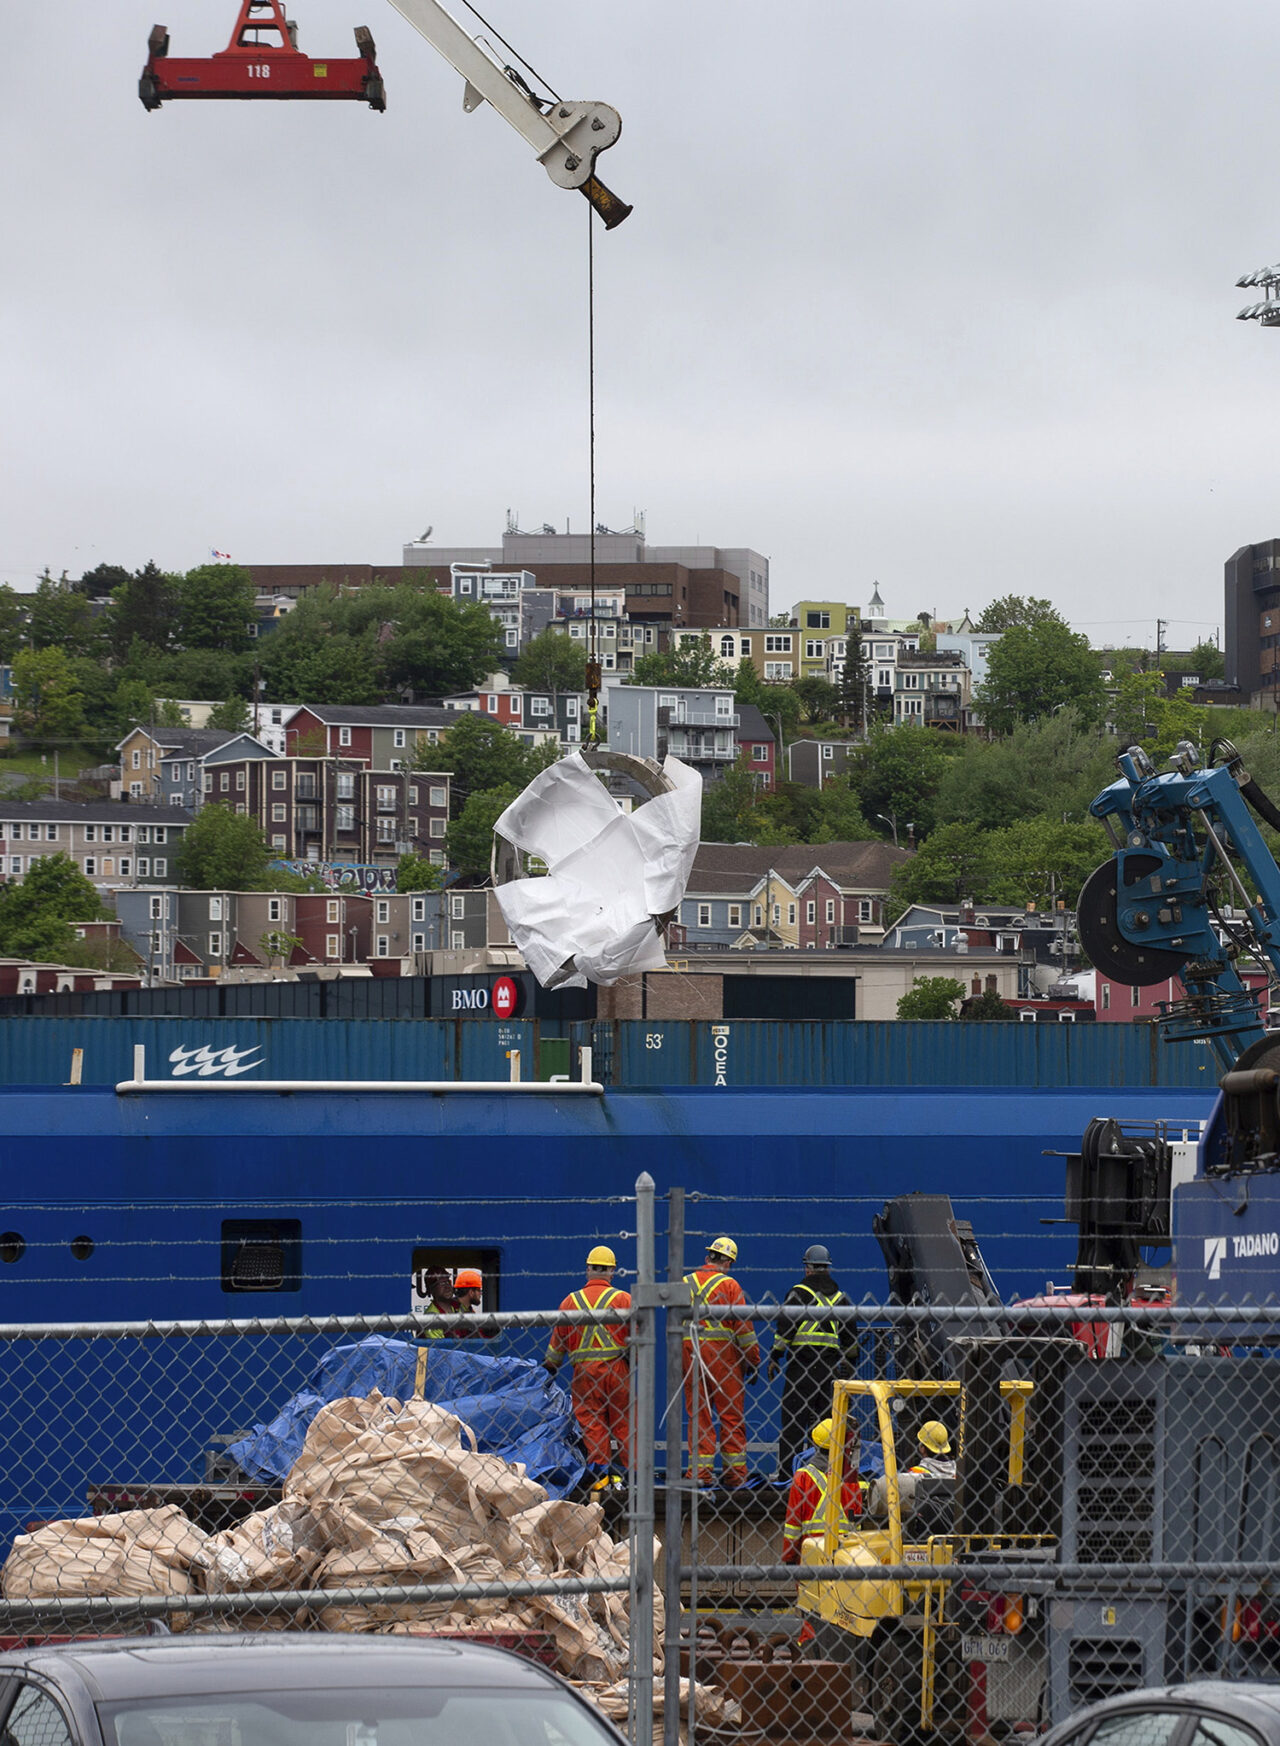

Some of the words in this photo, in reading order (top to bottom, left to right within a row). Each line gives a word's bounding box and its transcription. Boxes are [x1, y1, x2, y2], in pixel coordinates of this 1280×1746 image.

[246, 64, 271, 78] 118
[451, 988, 488, 1010] BMO
[645, 1033, 664, 1049] 53'
[1232, 1232, 1279, 1258] TADANO
[988, 1642, 1008, 1657] 069
